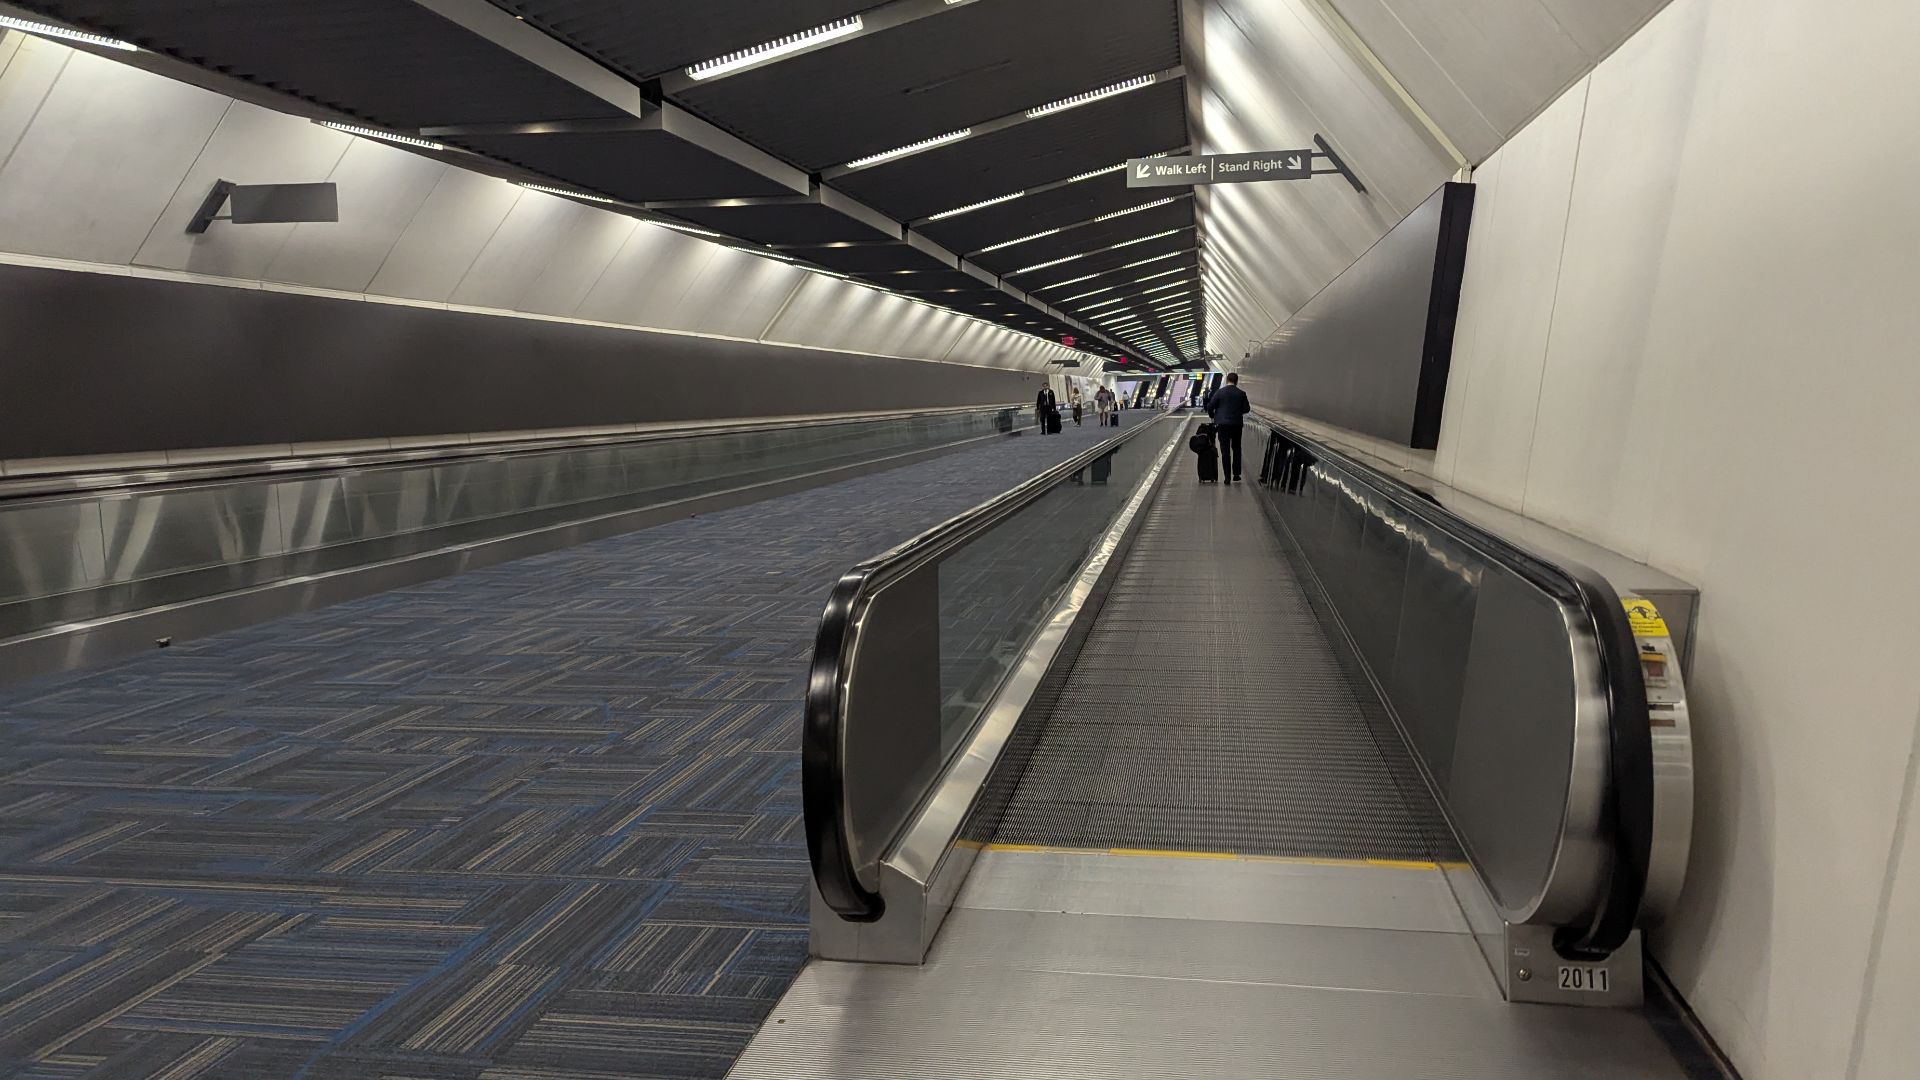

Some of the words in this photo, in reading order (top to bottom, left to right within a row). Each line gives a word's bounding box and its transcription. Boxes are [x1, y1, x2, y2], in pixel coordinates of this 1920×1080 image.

[1155, 165, 1183, 176] Walk
[1185, 164, 1207, 174] Left
[1218, 162, 1250, 173] Stand
[1253, 159, 1283, 172] Right
[1561, 968, 1607, 990] 2011
